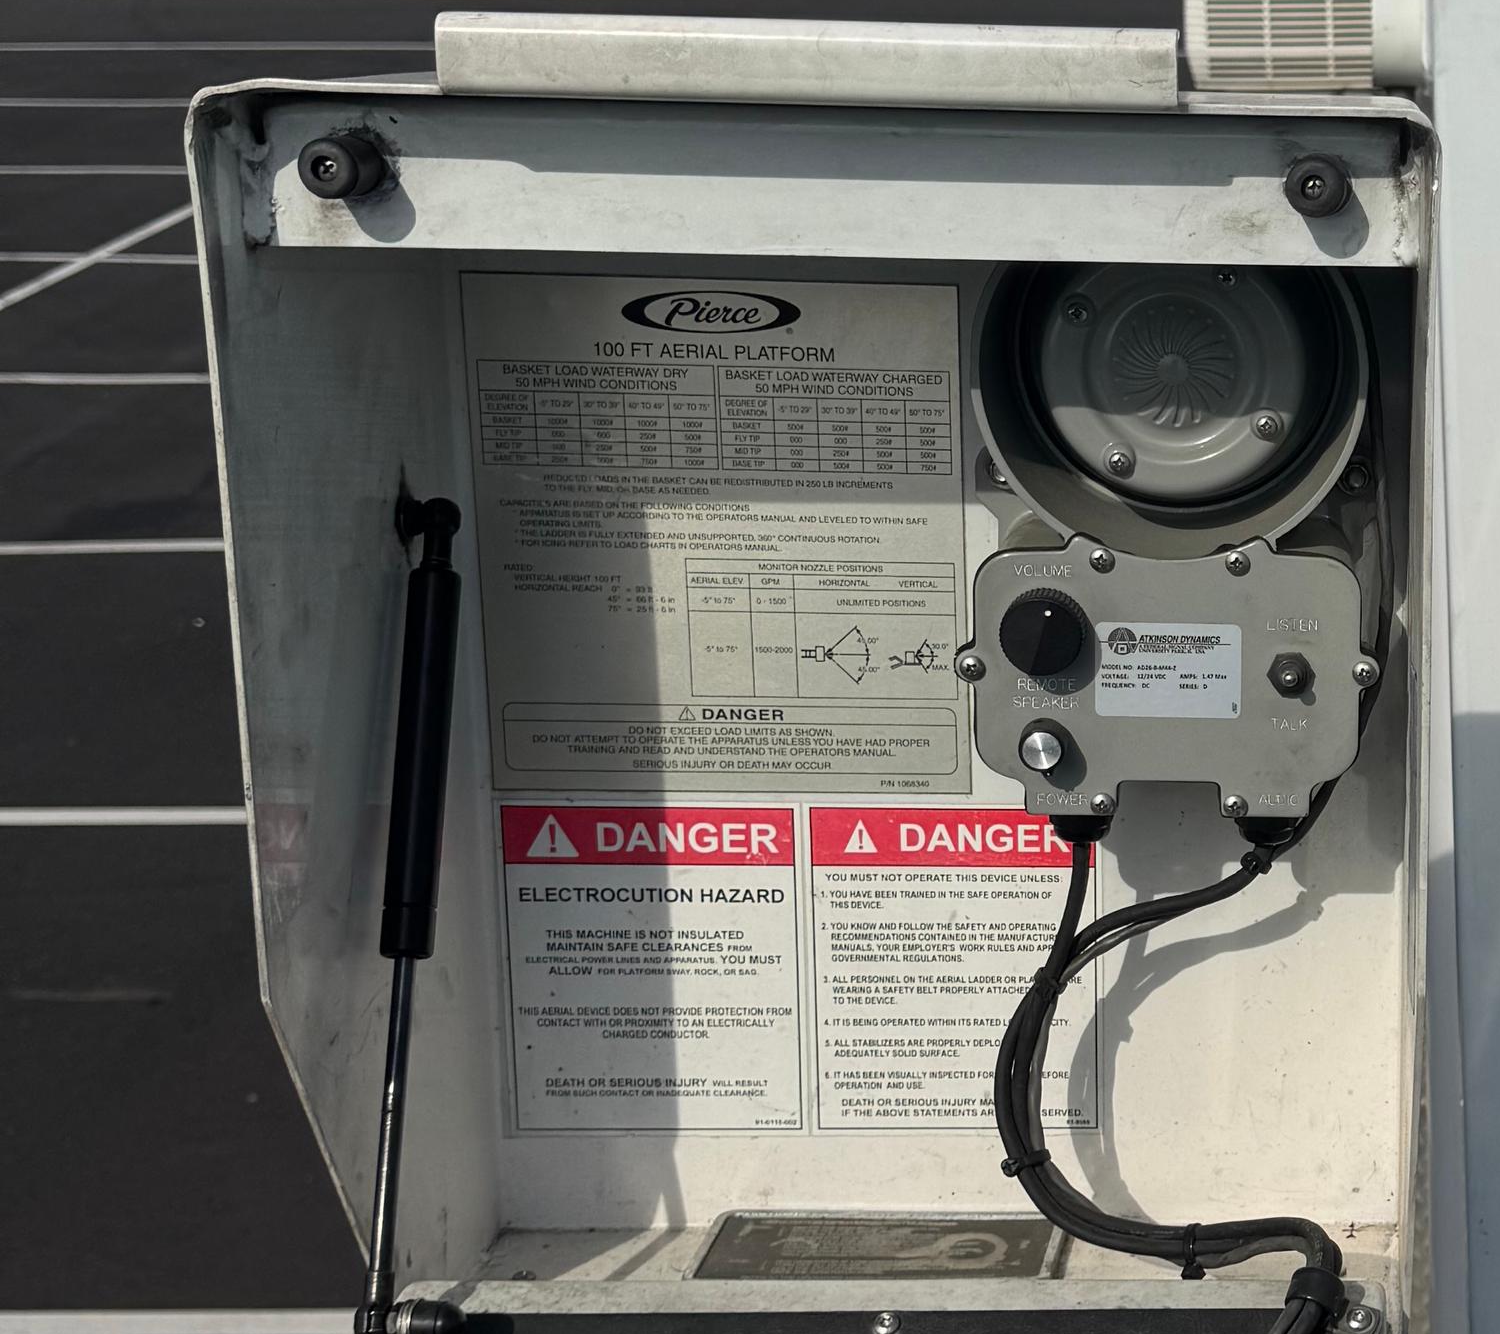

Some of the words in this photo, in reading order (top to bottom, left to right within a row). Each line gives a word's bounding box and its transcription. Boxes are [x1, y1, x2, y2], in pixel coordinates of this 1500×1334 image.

[664, 299, 763, 325] Pierce
[594, 342, 624, 357] 100
[632, 343, 653, 357] FT
[660, 344, 728, 359] AERIAL
[735, 346, 835, 362] PLATFORM
[503, 364, 551, 375] BASKET
[555, 366, 588, 376] LOAD
[591, 366, 659, 377] WATERWAY
[664, 368, 688, 378] DRY
[726, 370, 773, 381] BASKET
[776, 371, 809, 382] LOAD
[811, 372, 878, 384] WATERWAY
[882, 374, 942, 385] CHARGED
[516, 378, 529, 388] 50
[533, 379, 560, 388] MPH
[564, 379, 595, 389] WIND
[600, 380, 677, 391] CONDITIONS
[756, 383, 769, 393] 50
[772, 384, 799, 394] MPH
[802, 384, 834, 395] WIND
[838, 385, 913, 397] CONDITIONS
[759, 563, 798, 572] MONITOR
[801, 564, 834, 572] NOZZLE
[837, 564, 883, 573] POSITIONS
[1014, 565, 1072, 577] VOLUME
[1267, 619, 1318, 632] LISTEN
[1139, 635, 1180, 643] ATKINSON
[1181, 635, 1221, 643] DYNAMICS
[1018, 678, 1076, 690] REMOTE
[1013, 696, 1079, 709] SPEAKER
[702, 709, 784, 721] DANGER
[1271, 718, 1308, 730] TALK
[629, 726, 644, 735] DO
[647, 726, 667, 735] NOT
[670, 726, 712, 736] EXCEED
[715, 727, 742, 736] LOAD
[744, 727, 776, 736] LIMITS
[779, 727, 792, 737] AS
[795, 728, 835, 737] SHOWN.
[532, 734, 547, 744] DO
[550, 734, 570, 744] NOT
[574, 735, 619, 744] ATTEMPT
[623, 735, 636, 744] TO
[638, 735, 686, 745] OPERATE
[688, 736, 709, 745] THE
[711, 736, 769, 746] APPARATUS
[772, 737, 811, 746] UNLESS
[813, 738, 834, 746] YOU
[836, 738, 862, 746] HAVE
[865, 738, 886, 747] HAD
[889, 738, 930, 747] PROPER
[568, 745, 616, 754] TRAINING
[618, 746, 640, 755] AND
[642, 746, 671, 755] READ
[673, 746, 696, 755] AND
[698, 747, 766, 756] UNDERSTAND
[768, 747, 787, 756] THE
[790, 748, 850, 756] OPERATORS
[853, 748, 896, 757] MANUAL.
[632, 759, 678, 768] SERIOUS
[681, 760, 716, 769] INJURY
[719, 760, 735, 769] OR
[738, 761, 769, 769] DEATH
[772, 761, 792, 769] MAY
[795, 761, 832, 769] OCCUR
[1037, 794, 1088, 805] POWER
[1259, 795, 1298, 805] AUDIO
[596, 823, 779, 853] DANGER
[825, 874, 847, 882] YOU
[851, 874, 878, 882] MUST
[881, 874, 901, 882] NOT
[905, 874, 952, 882] OPERATE
[956, 874, 977, 882] THIS
[981, 874, 1017, 882] DEVICE
[1020, 874, 1063, 882] UNLESS:
[519, 888, 693, 903] ELECTROCUTION
[701, 888, 784, 903] HAZARD
[821, 891, 828, 899] 1.
[830, 891, 847, 899] YOU
[850, 891, 872, 899] HAVE
[875, 891, 897, 899] BEEN
[900, 891, 936, 899] TRAINED
[938, 891, 946, 899] IN
[949, 891, 965, 899] THE
[967, 891, 989, 899] SAFE
[991, 891, 1039, 899] OPERATION
[1042, 891, 1052, 899] OF
[831, 901, 849, 909] THIS
[851, 901, 884, 909] DEVICE.
[821, 923, 829, 931] 2.
[831, 923, 848, 931] YOU
[851, 923, 877, 931] KNOW
[879, 923, 896, 931] AND
[899, 923, 934, 931] FOLLOW
[937, 923, 952, 931] THE
[955, 923, 986, 931] SAFETY
[989, 923, 1006, 931] AND
[1009, 923, 1056, 931] OPERATING
[546, 930, 573, 939] THIS
[576, 930, 631, 939] MACHINE
[635, 930, 646, 939] IS
[650, 930, 674, 939] NOT
[678, 930, 744, 939] INSULATED
[547, 942, 603, 951] MAINTAIN
[607, 943, 638, 951] SAFE
[642, 943, 723, 952] CLEARANCES
